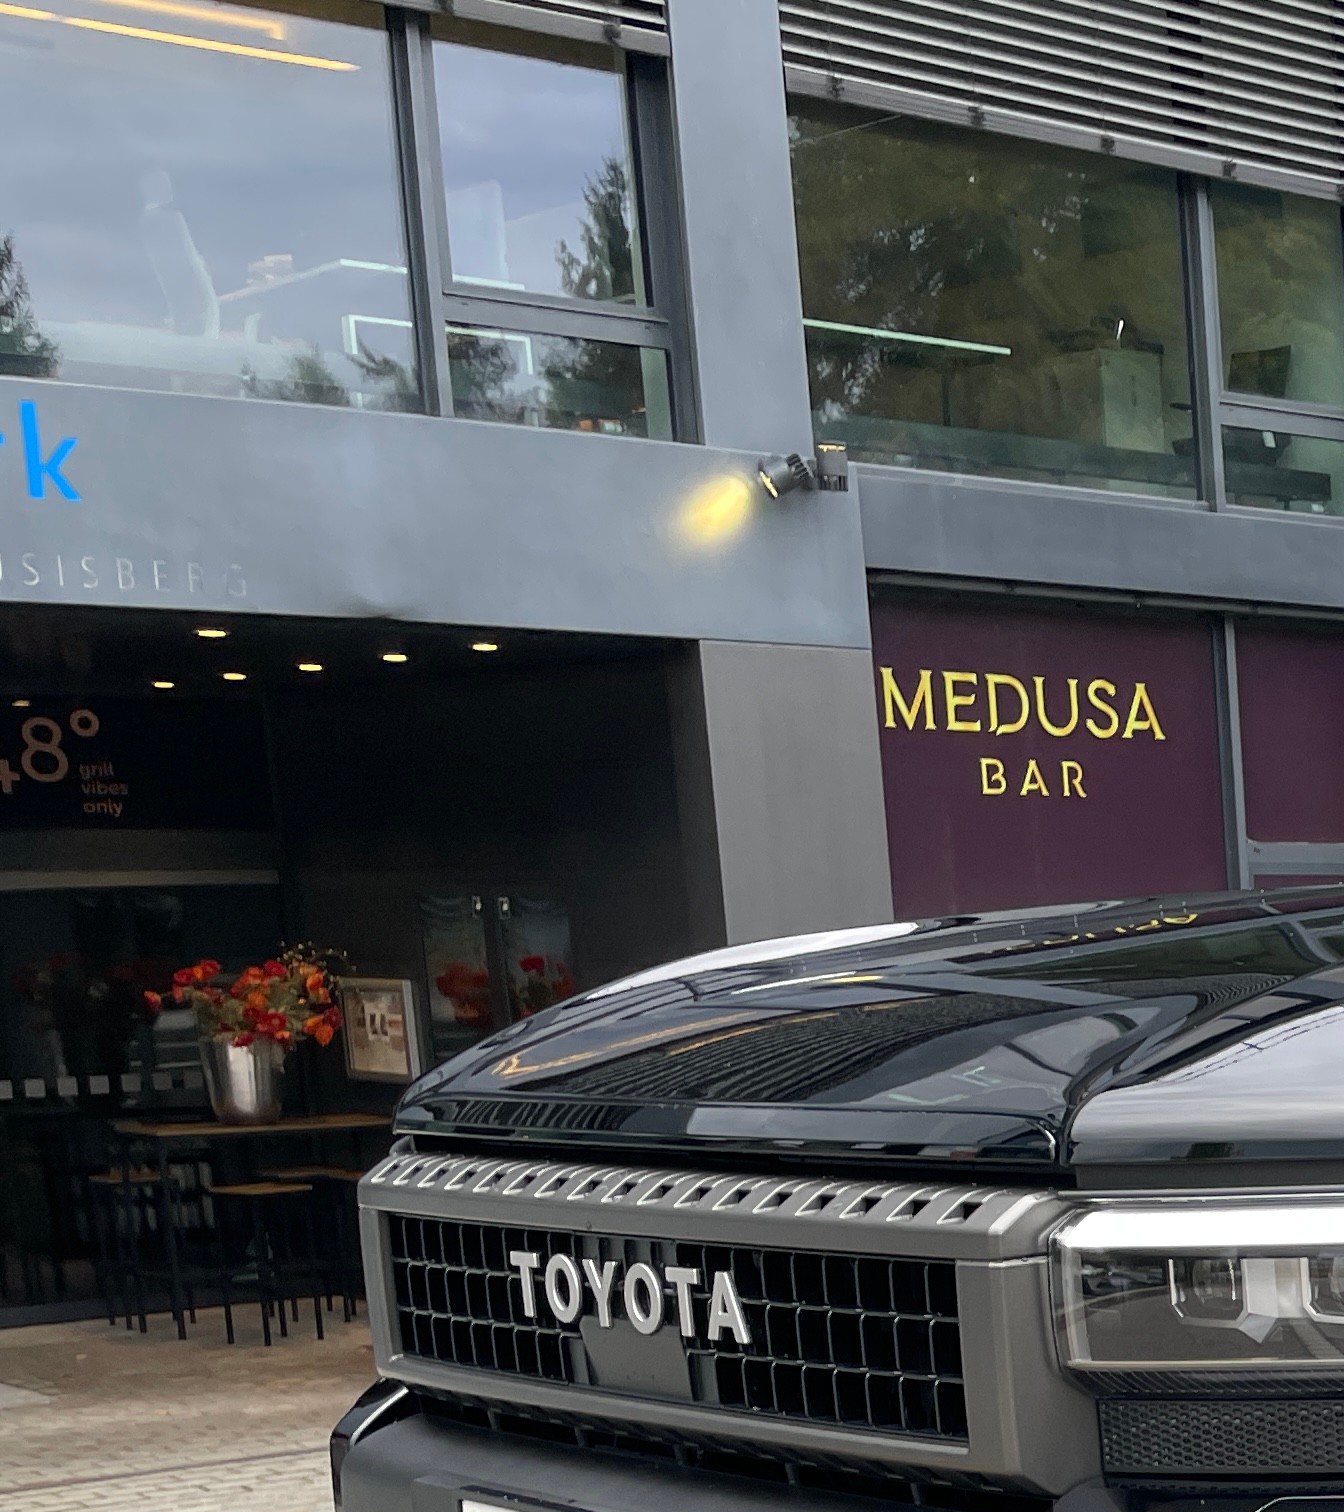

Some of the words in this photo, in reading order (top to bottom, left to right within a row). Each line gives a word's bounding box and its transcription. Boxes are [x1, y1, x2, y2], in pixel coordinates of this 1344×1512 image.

[0, 400, 82, 501] k
[0, 552, 248, 599] SISBERG
[879, 666, 1166, 741] MEDUSA
[81, 780, 128, 796] vibes
[979, 757, 1087, 799] BAR
[83, 798, 123, 817] only
[509, 1250, 751, 1345] TOYOTA
